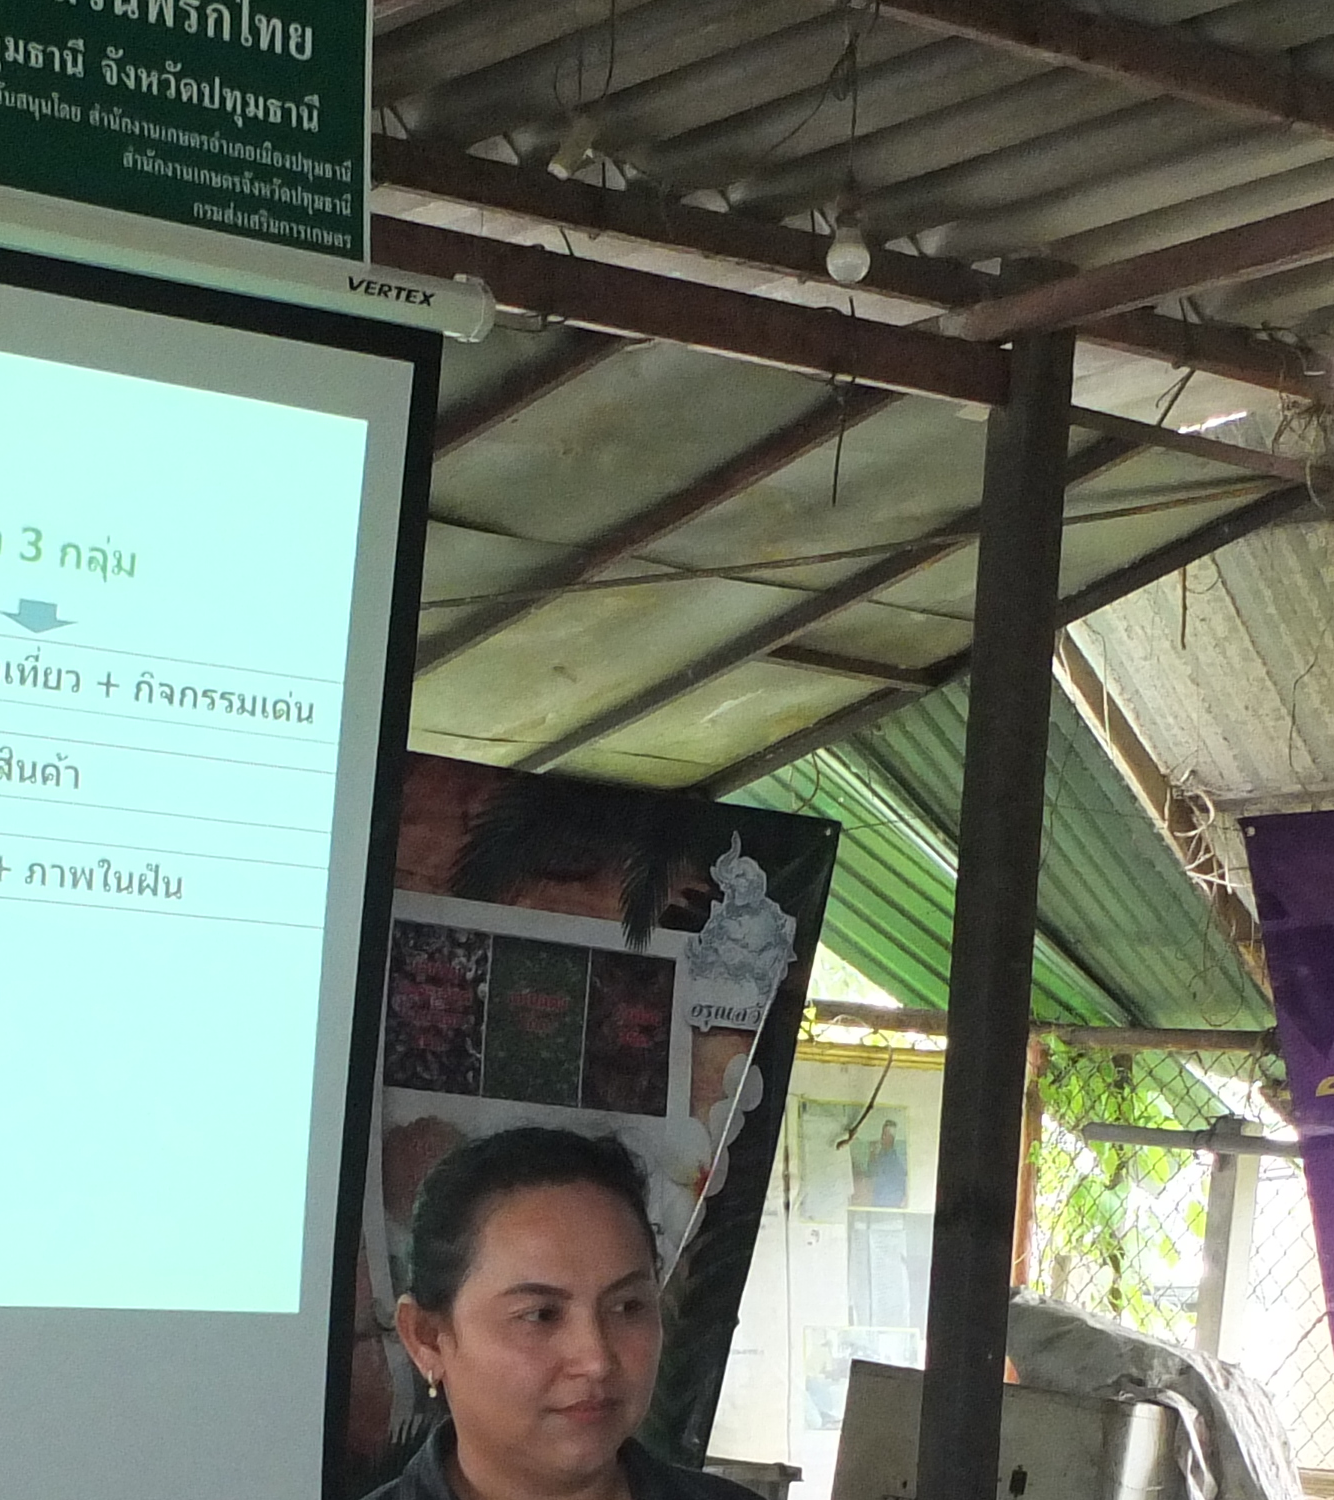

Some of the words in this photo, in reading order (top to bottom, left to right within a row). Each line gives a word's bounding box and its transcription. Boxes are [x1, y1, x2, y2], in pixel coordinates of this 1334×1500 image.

[101, 46, 321, 134] จังหวัดปทุมธานี
[347, 275, 436, 308] VERTEX
[18, 526, 44, 563] 3
[58, 535, 138, 583] กลุ่ม
[134, 671, 316, 726] กิจกรรมเด่น
[24, 858, 185, 902] ภาพในฝัน
